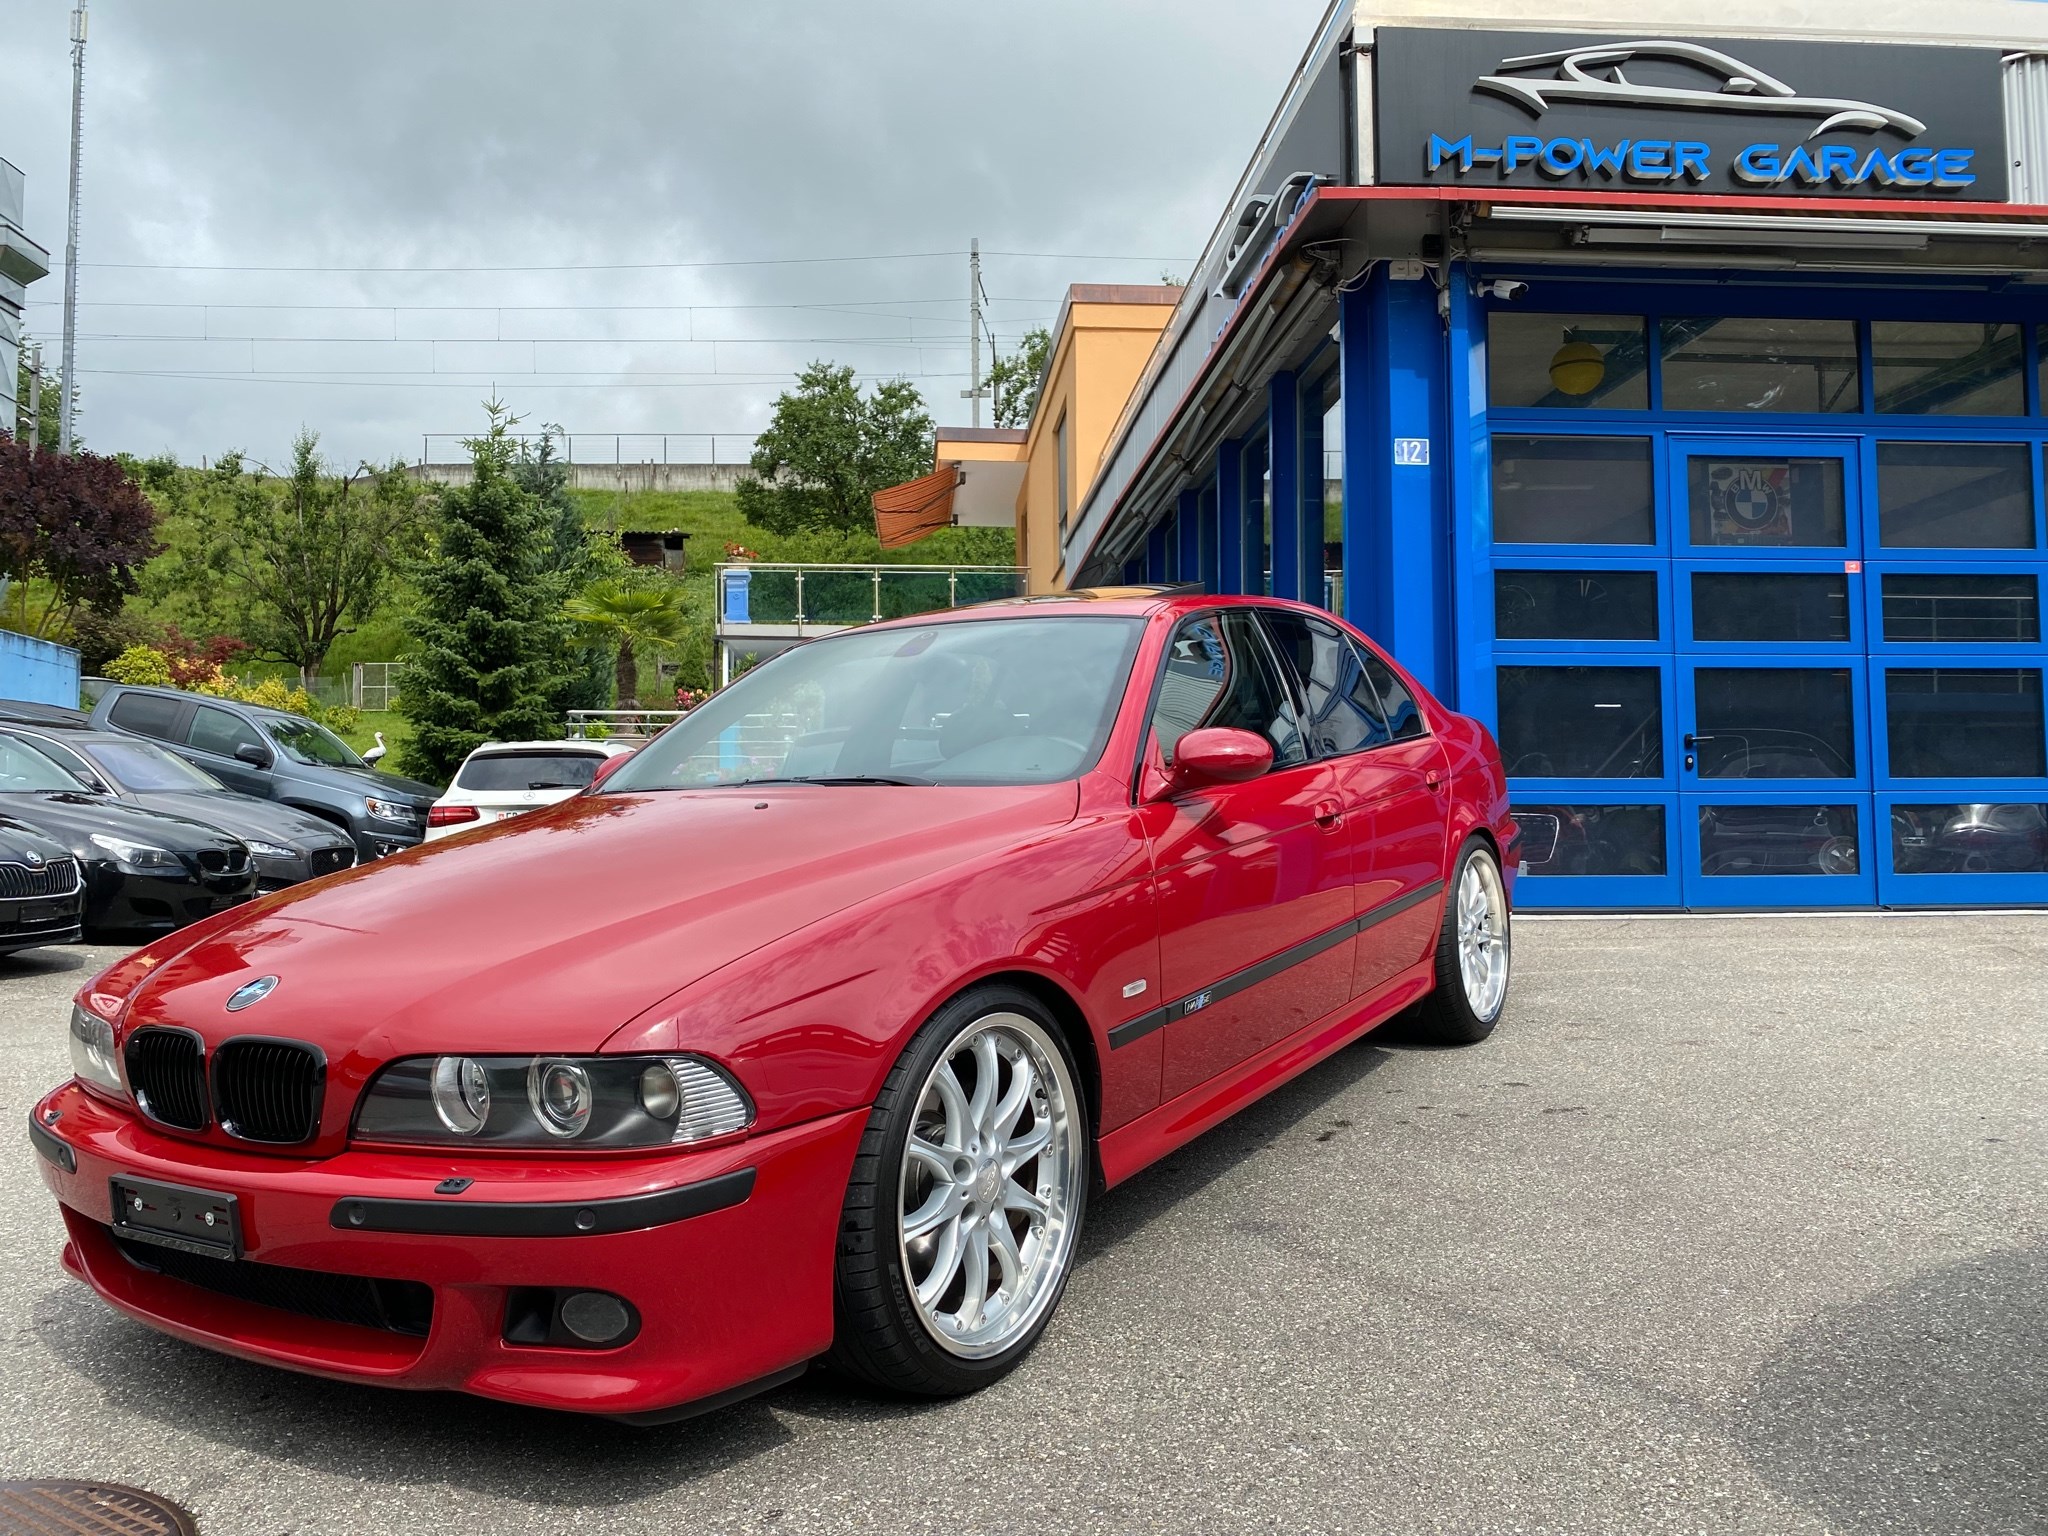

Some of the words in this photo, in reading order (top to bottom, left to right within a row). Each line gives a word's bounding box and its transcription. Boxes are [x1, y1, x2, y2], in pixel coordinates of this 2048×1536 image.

[1429, 133, 1712, 179] M-POWER
[1736, 143, 1977, 186] GARAGE
[1402, 441, 1422, 462] 12
[1730, 470, 1773, 495] BMW
[889, 1273, 920, 1341] DUNLOP
